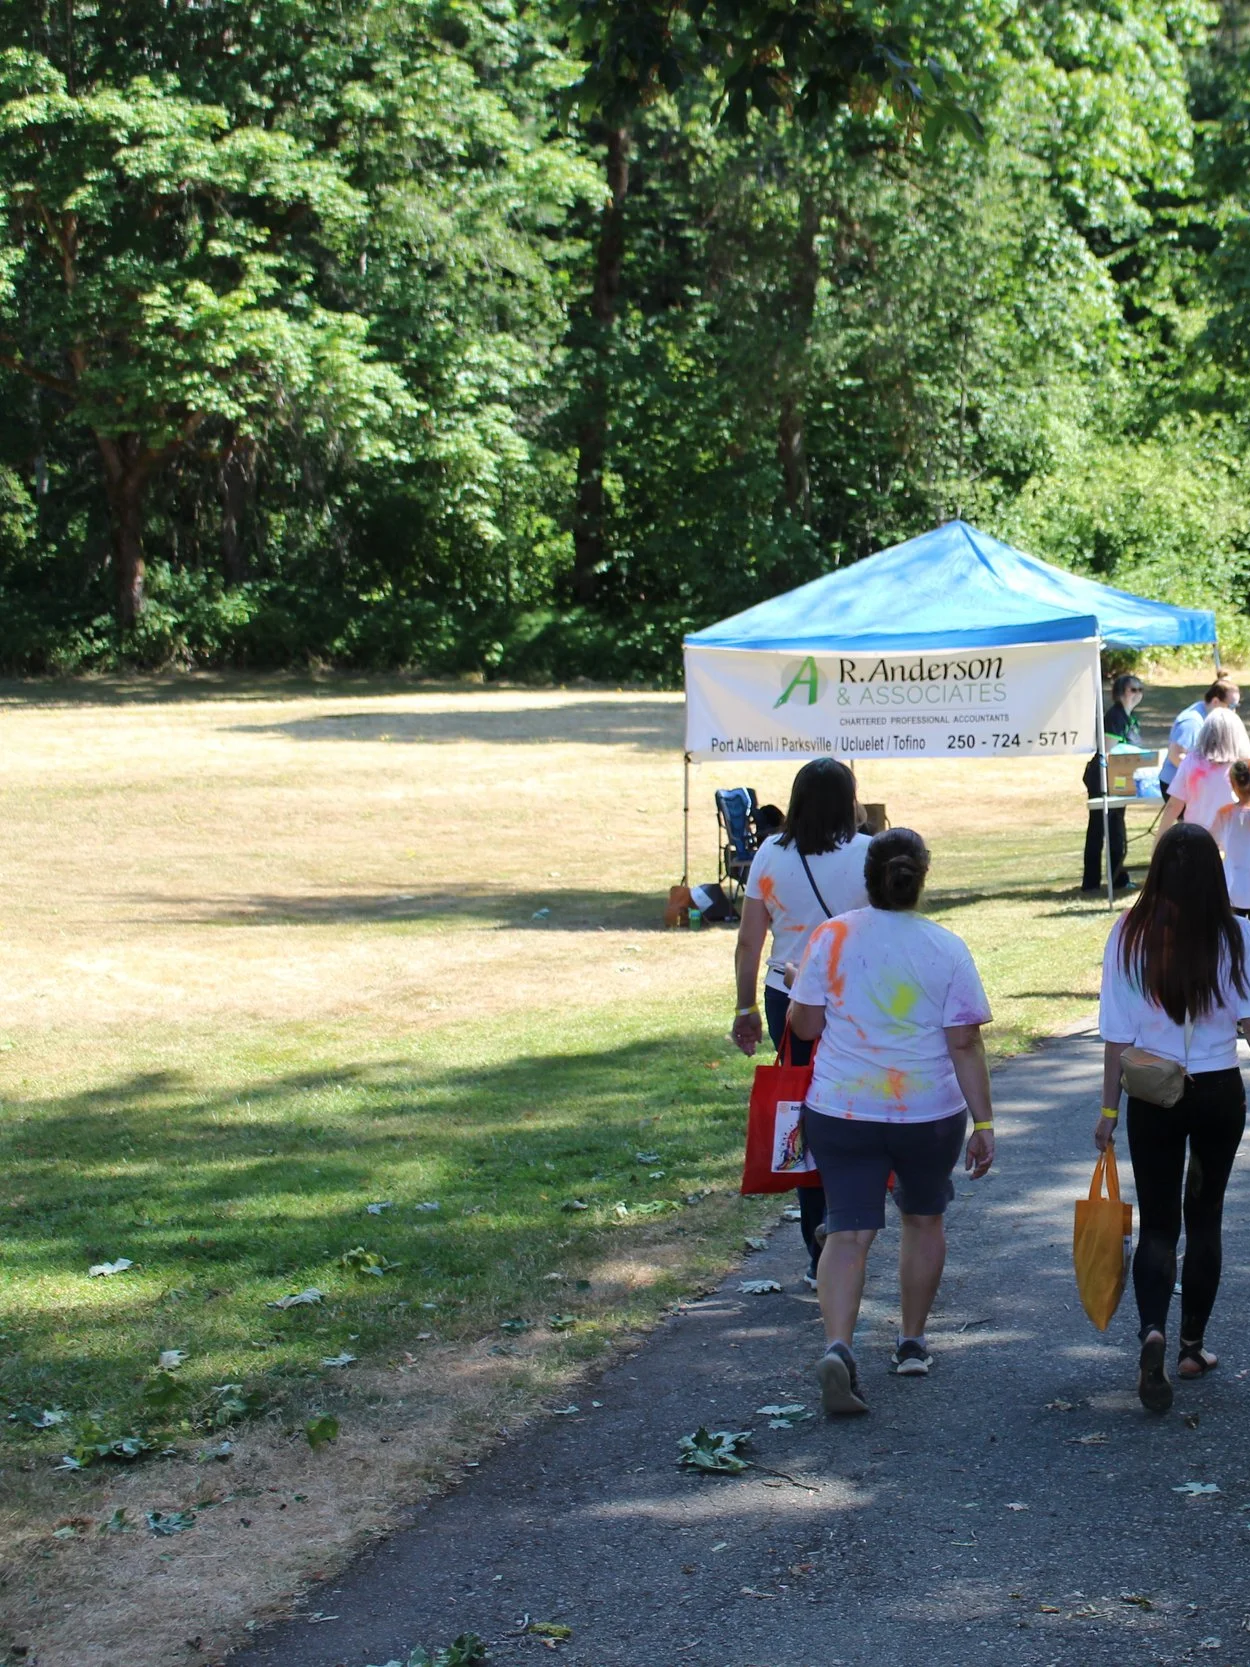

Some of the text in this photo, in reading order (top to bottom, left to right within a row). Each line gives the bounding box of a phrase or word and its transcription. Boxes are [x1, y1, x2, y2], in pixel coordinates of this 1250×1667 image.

[837, 683, 1007, 705] & ASSOCIATES
[840, 714, 1009, 726] CHARTERED PROFESSIONAL ACCOUNTANTS
[711, 737, 734, 752] Port
[737, 737, 773, 752] Alberni
[782, 737, 831, 751] Parksville
[841, 736, 884, 751] Ucluelet
[893, 735, 926, 750] Tofino
[947, 735, 976, 749] 250
[992, 733, 1021, 748] 724
[1039, 731, 1078, 746] 5717
